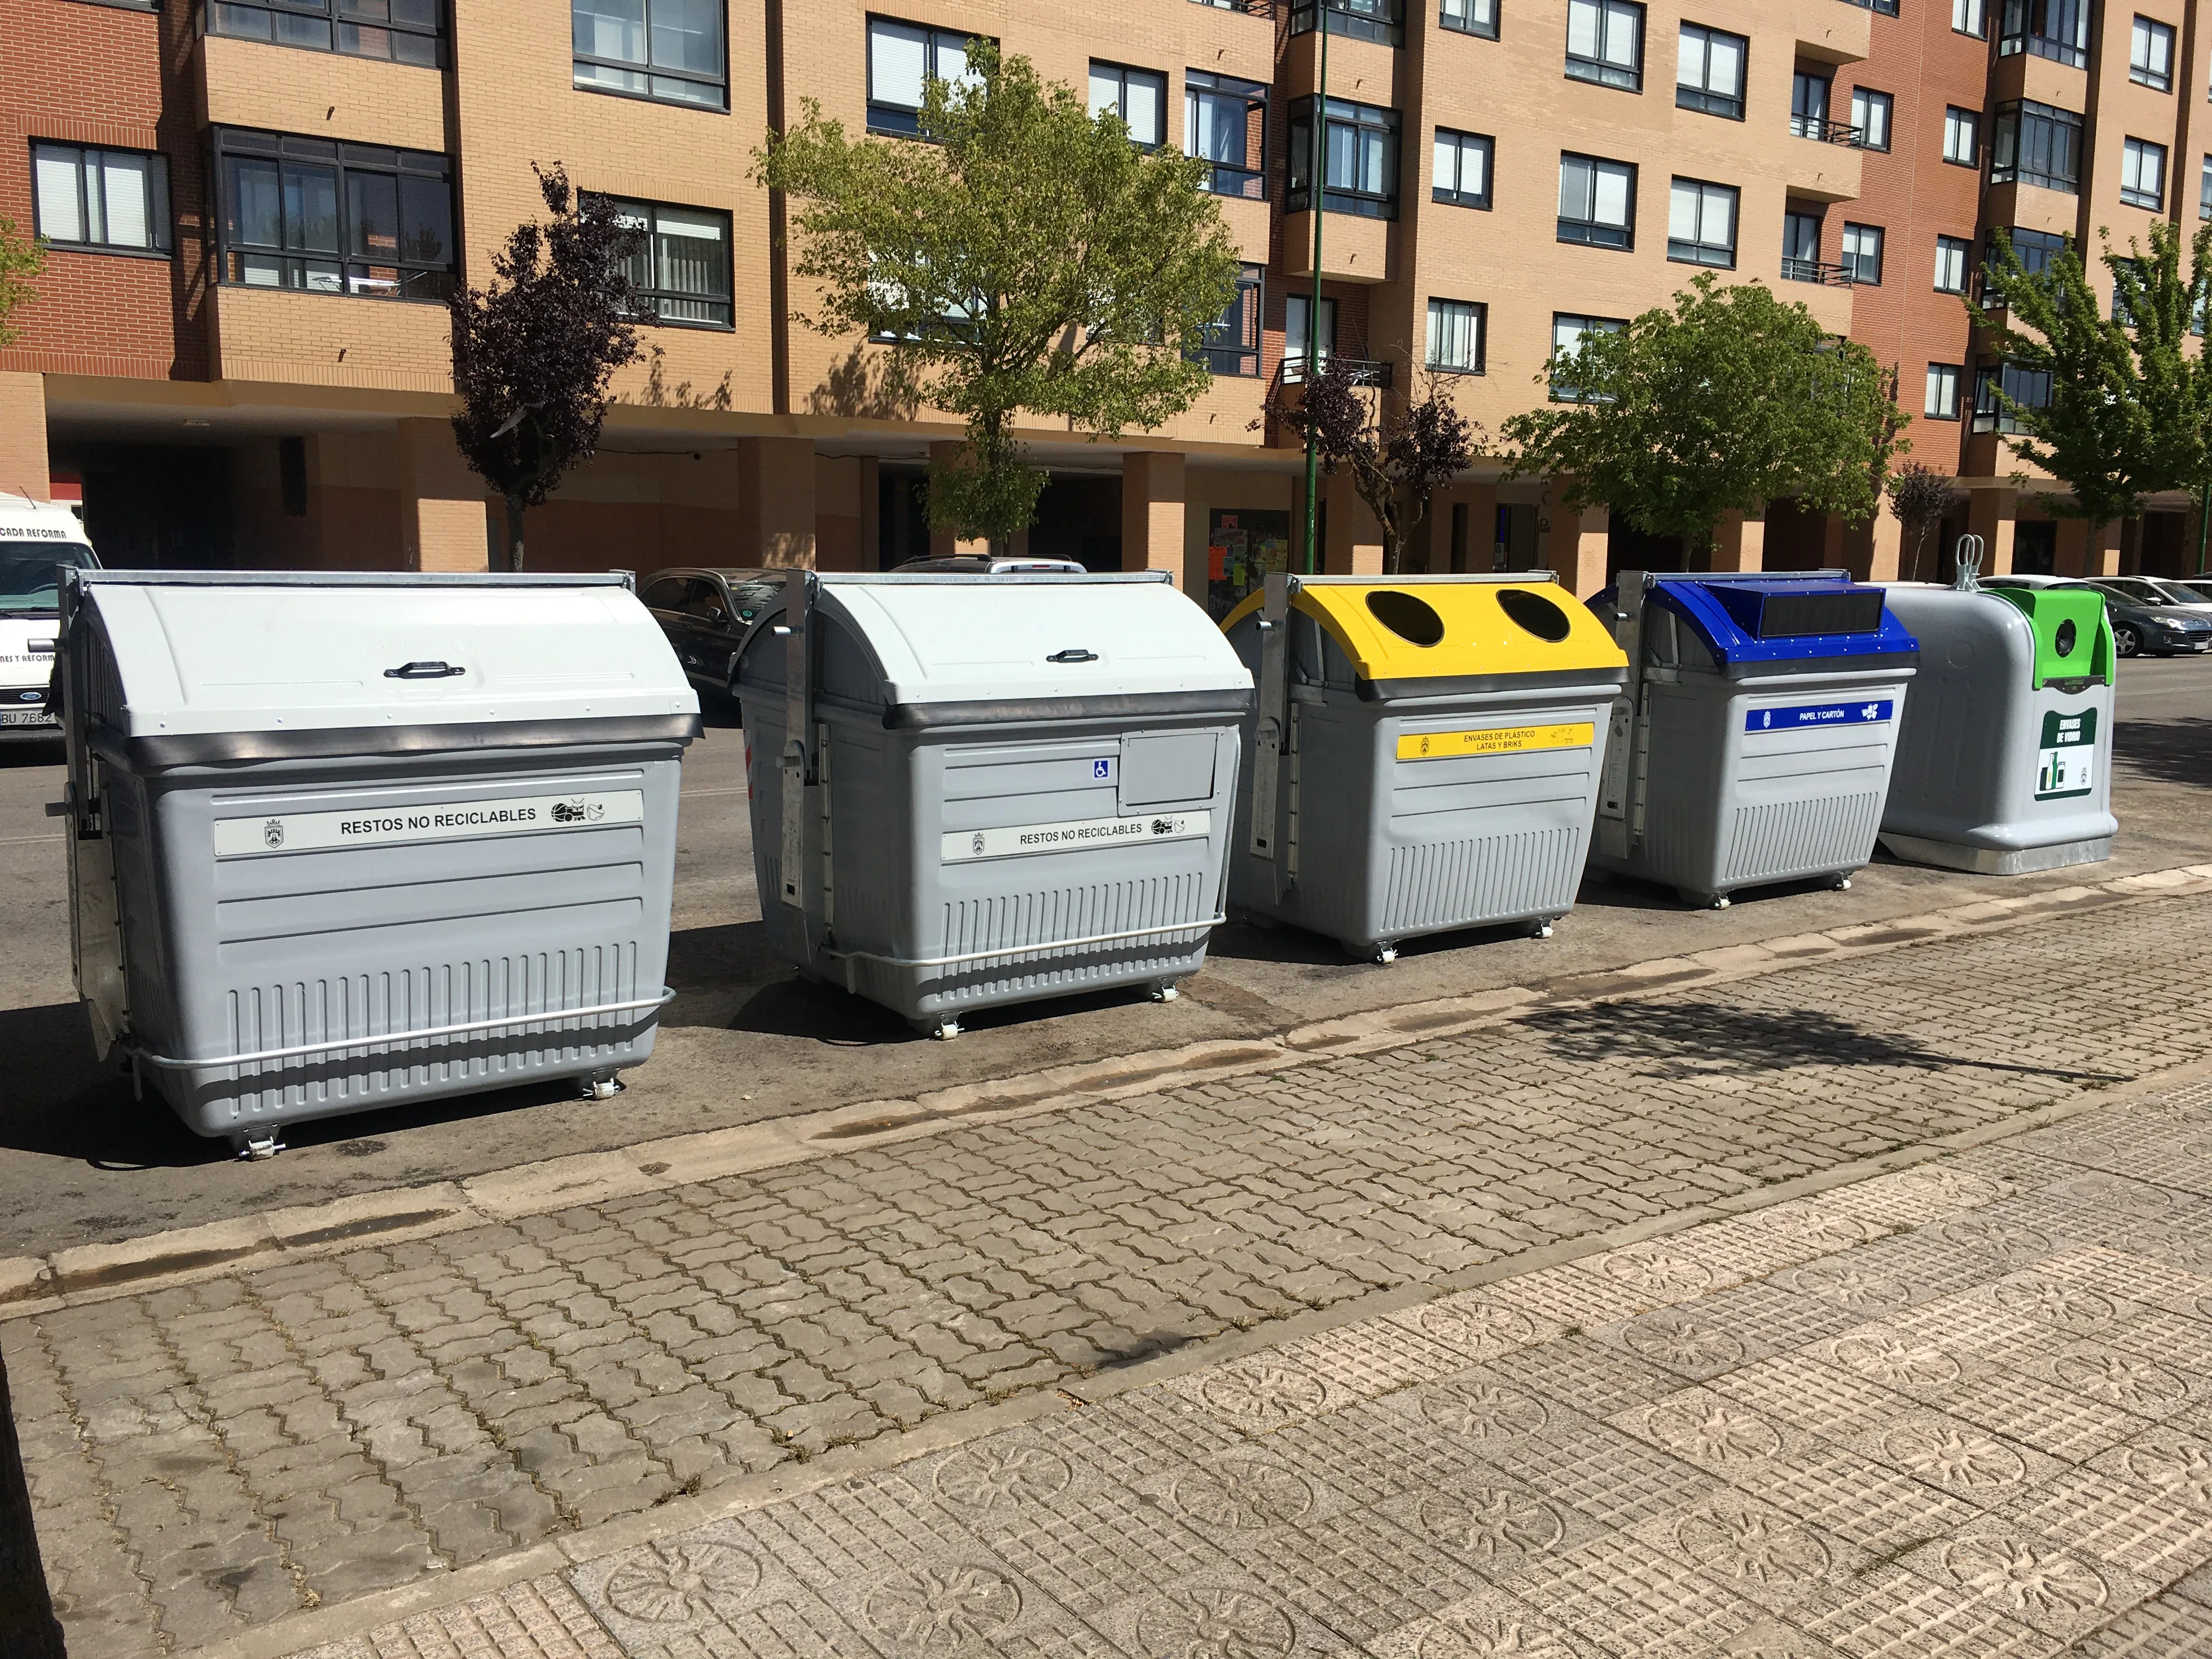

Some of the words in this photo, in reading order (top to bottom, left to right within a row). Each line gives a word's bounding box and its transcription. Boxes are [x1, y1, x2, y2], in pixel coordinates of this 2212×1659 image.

[26, 528, 67, 539] REFORMA
[1, 714, 16, 724] BU
[22, 713, 52, 723] 7682
[1799, 712, 1816, 720] PAPEL
[1821, 708, 1844, 719] CARTÓN
[2059, 718, 2081, 730] ENVASES
[1464, 733, 1493, 742] ENVASES
[1505, 730, 1535, 739] PLÁSTICO
[2057, 732, 2064, 743] DE
[2064, 731, 2080, 742] VIDRIO
[341, 818, 403, 834] RESTOS
[408, 816, 430, 829] NO
[435, 808, 536, 827] RECICLABLES
[1020, 832, 1059, 845] RESTOS
[1062, 830, 1075, 840] NO
[1078, 823, 1142, 839] RECICLABLES
